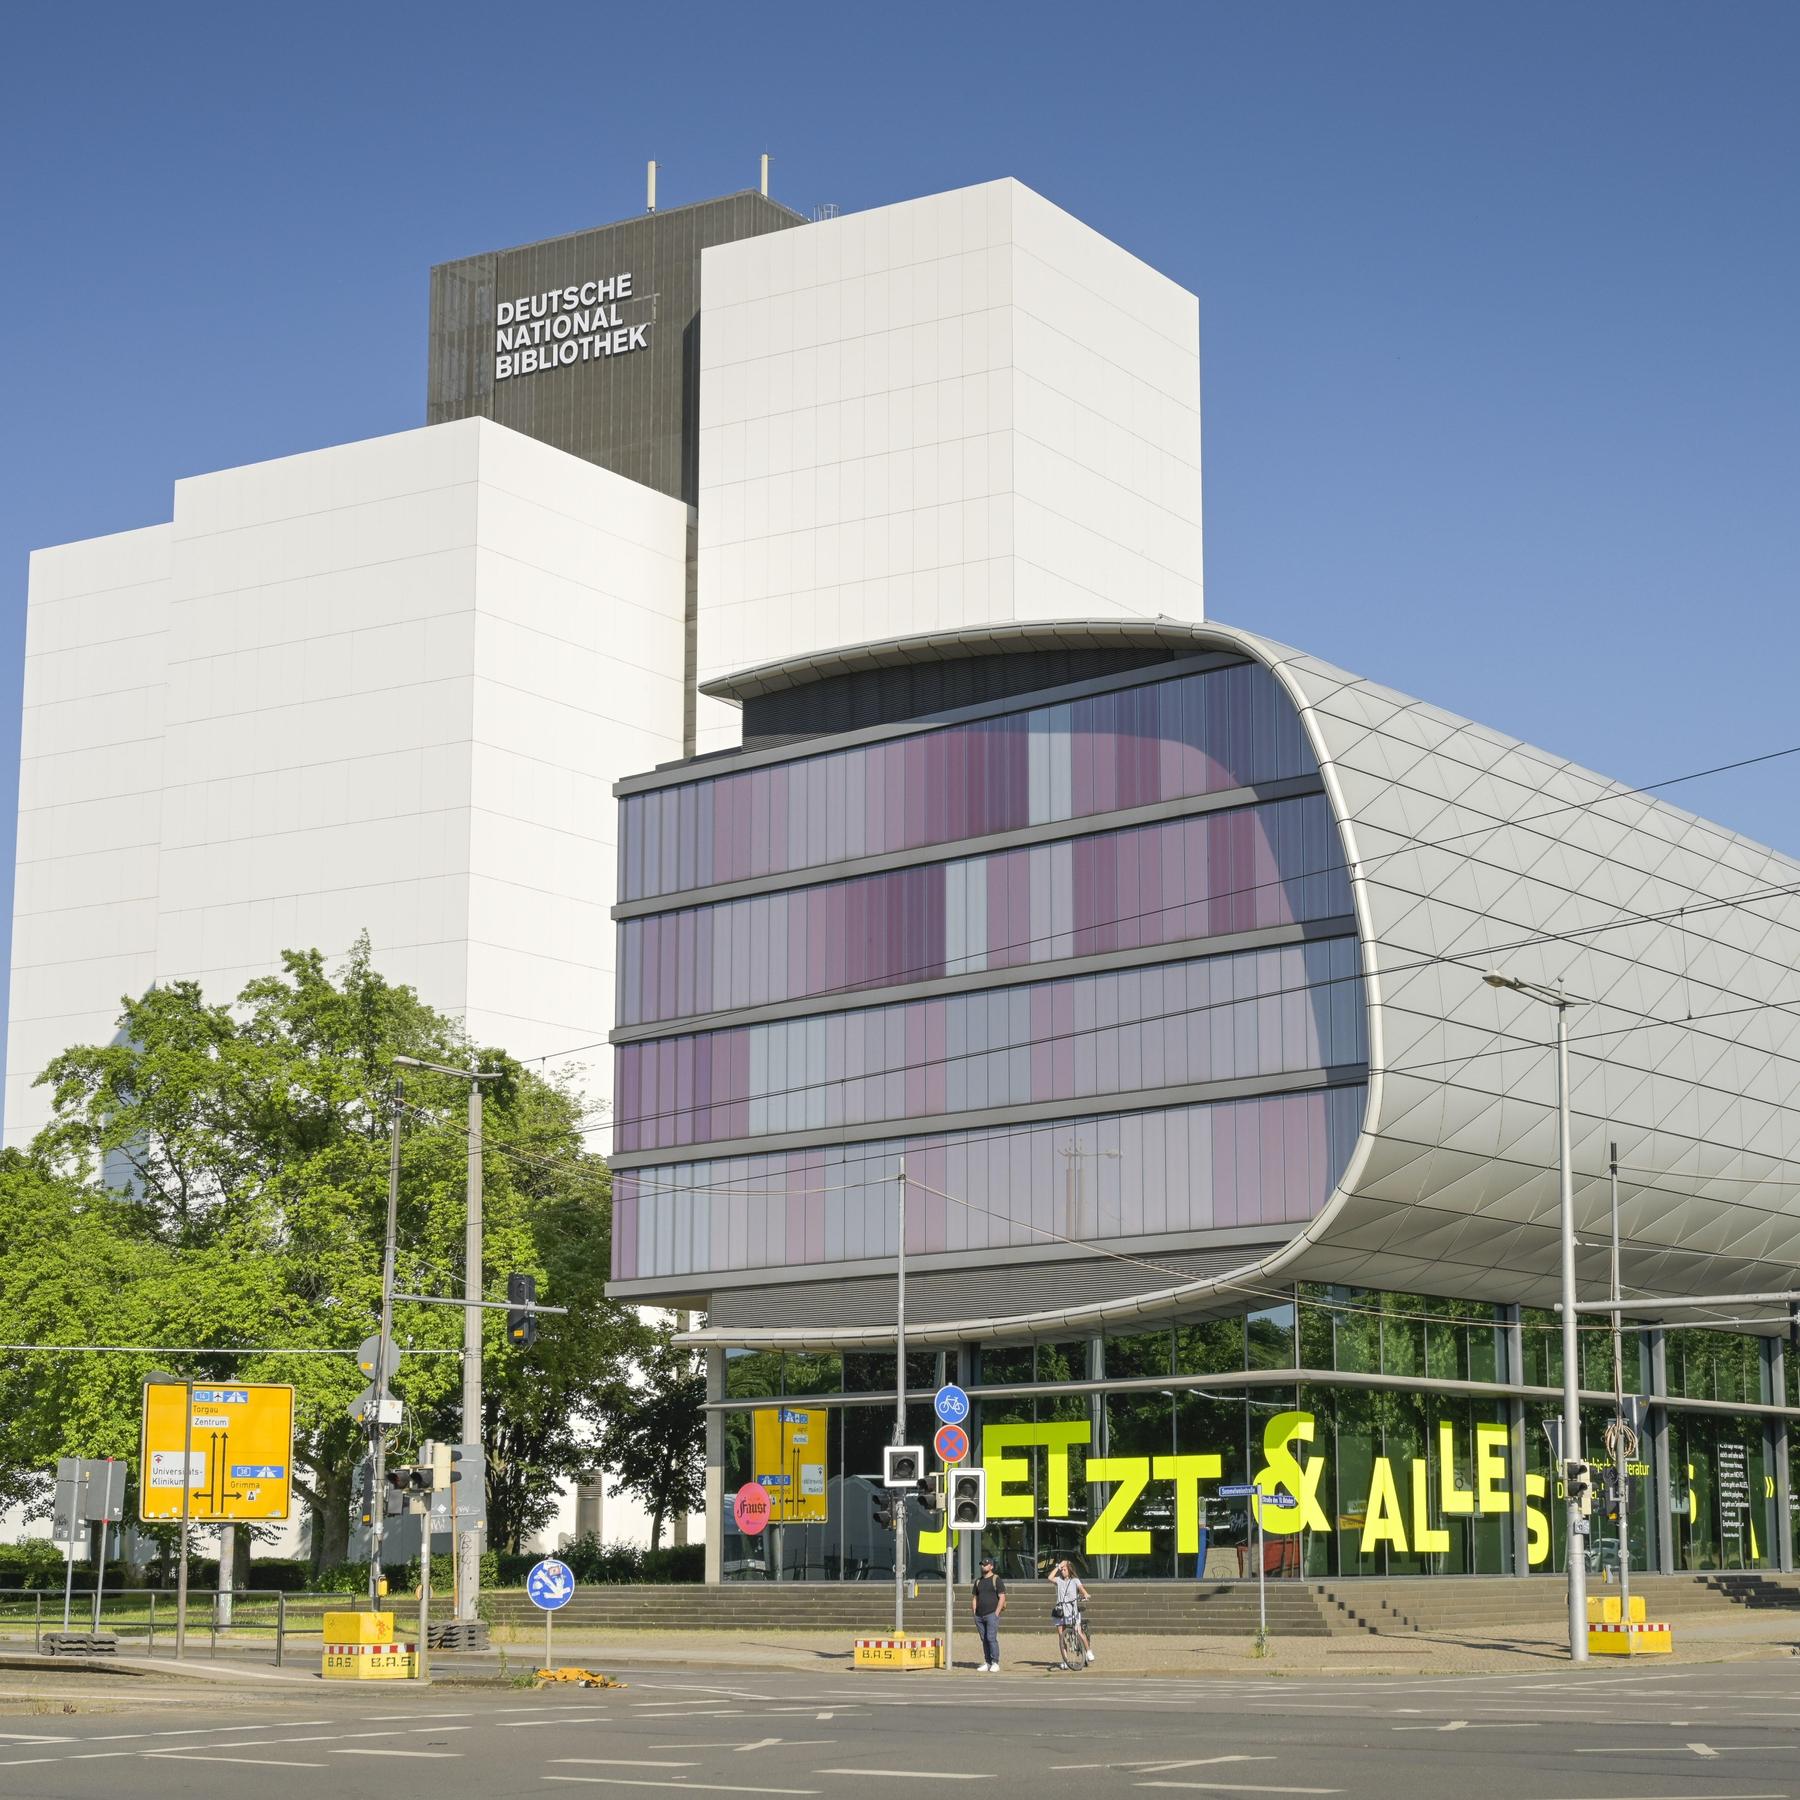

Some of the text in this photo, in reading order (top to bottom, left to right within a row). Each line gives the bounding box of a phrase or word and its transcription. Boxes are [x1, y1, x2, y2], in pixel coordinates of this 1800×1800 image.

[497, 273, 632, 326] DEUTSCHE
[496, 303, 623, 352] NATIONAL
[496, 324, 648, 379] BIBLIOTHEK
[193, 1405, 219, 1414] Torgau
[195, 1417, 227, 1426] Zentrum
[230, 1481, 260, 1489] Grimma
[1252, 1411, 1331, 1535] &
[1360, 1420, 1550, 1565] ALLES
[737, 1499, 767, 1518] Faust
[371, 1656, 415, 1668] B.A.S.
[862, 1650, 895, 1660] B.A.S.
